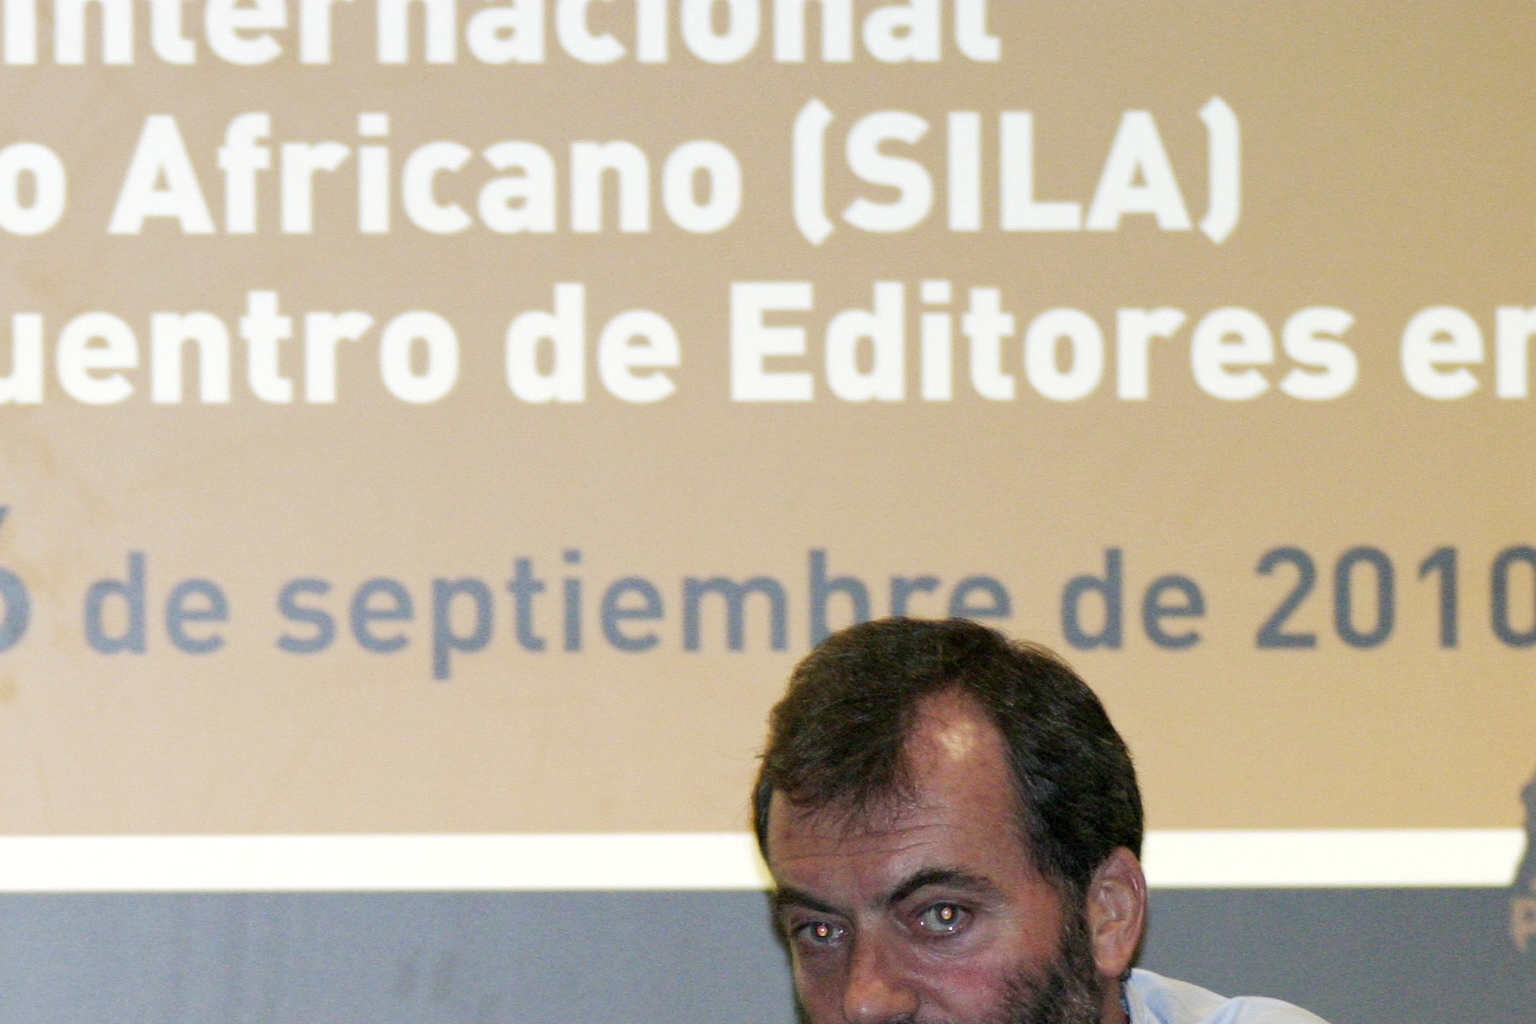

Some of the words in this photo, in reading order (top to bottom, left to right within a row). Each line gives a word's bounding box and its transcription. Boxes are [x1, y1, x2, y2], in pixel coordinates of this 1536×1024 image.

[107, 112, 743, 235] Africano
[792, 96, 1241, 246] (SILA)
[505, 282, 681, 403] de
[730, 279, 1360, 402] Editores
[83, 551, 230, 655] de
[275, 549, 1012, 680] septiembre
[1061, 548, 1207, 650] de
[1255, 546, 1536, 650] 2010
